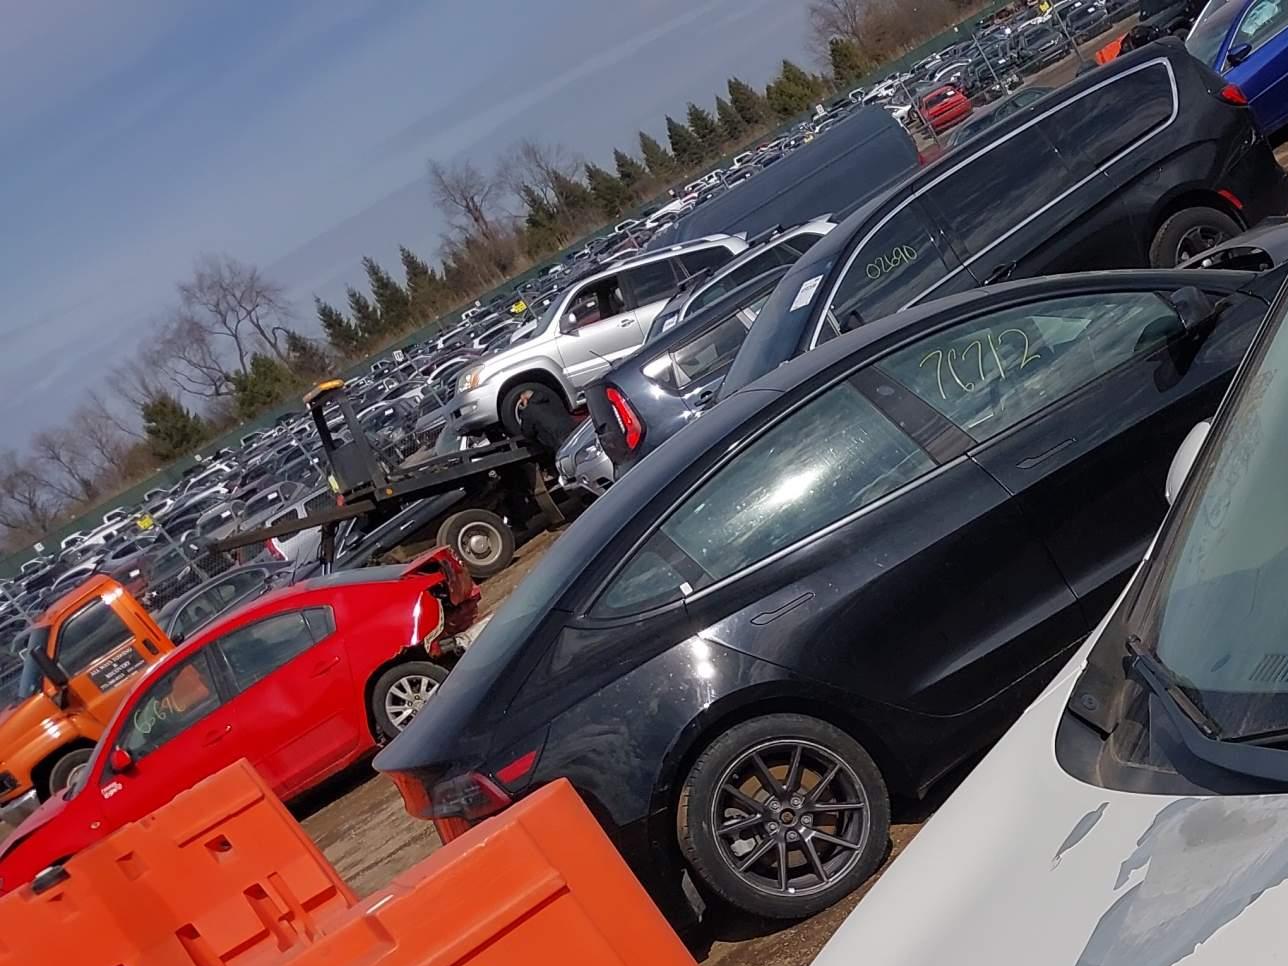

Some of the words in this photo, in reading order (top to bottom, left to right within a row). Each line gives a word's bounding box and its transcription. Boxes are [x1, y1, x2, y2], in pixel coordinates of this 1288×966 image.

[864, 243, 919, 281] 02690
[919, 327, 1042, 401] 76712
[105, 660, 131, 679] RECOVERY
